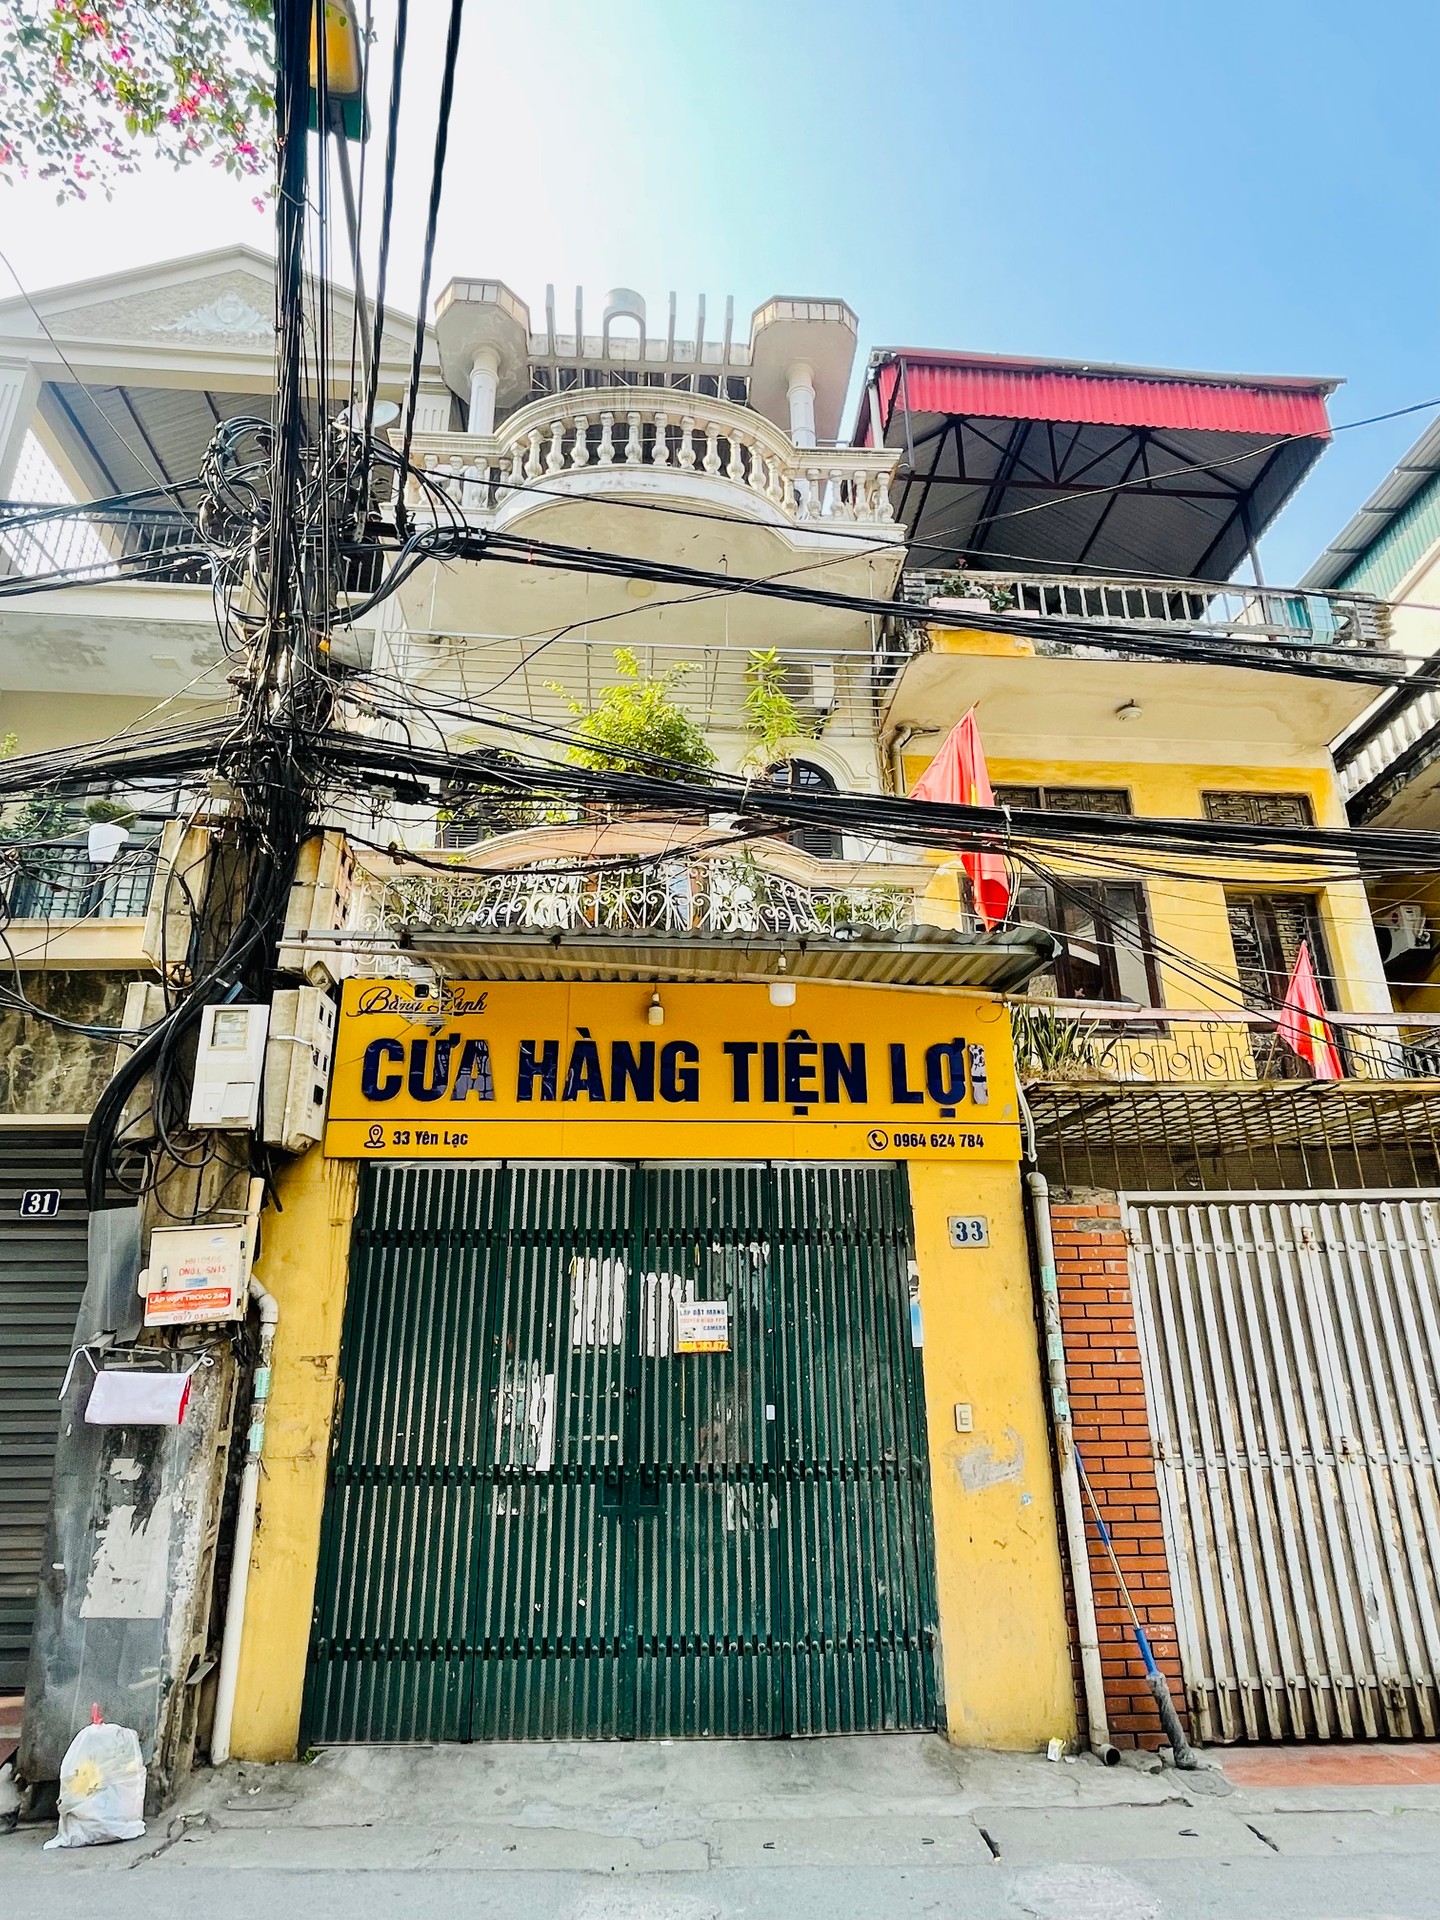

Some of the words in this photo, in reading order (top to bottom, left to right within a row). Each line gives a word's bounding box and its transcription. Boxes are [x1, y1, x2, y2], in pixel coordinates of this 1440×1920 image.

[516, 1027, 700, 1103] HÀNG
[723, 1029, 868, 1116] TIỆN
[890, 1037, 989, 1118] LỢI
[392, 1130, 411, 1145] 33
[415, 1130, 438, 1145] Yên
[443, 1130, 469, 1148] Lạc
[893, 1133, 927, 1148] 0964
[930, 1133, 955, 1148] 624
[959, 1133, 984, 1148] 784
[29, 1193, 51, 1213] 31
[956, 1221, 984, 1241] 33
[185, 1292, 212, 1302] TRONG
[212, 1291, 229, 1299] 24H
